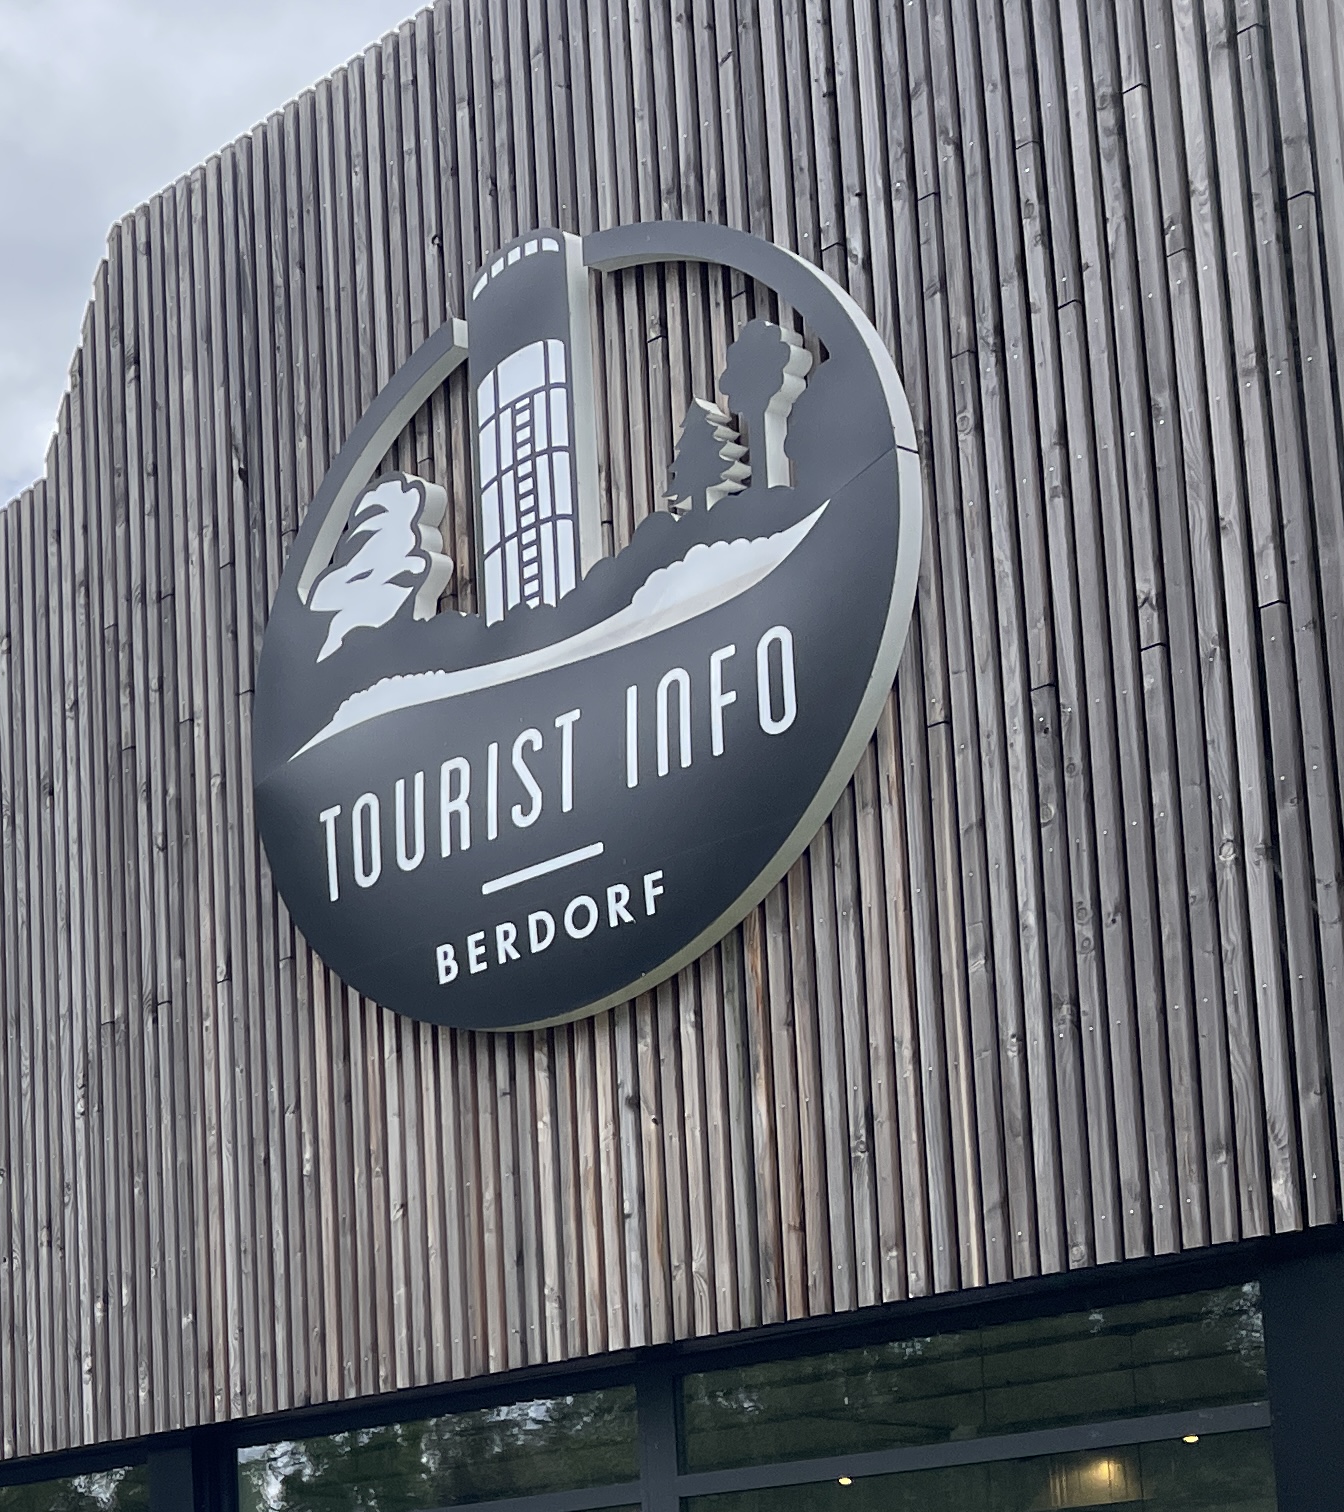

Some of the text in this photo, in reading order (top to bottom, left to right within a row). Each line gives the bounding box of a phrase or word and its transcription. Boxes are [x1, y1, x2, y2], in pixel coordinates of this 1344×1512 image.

[319, 625, 798, 902] TOURIST INFO
[435, 869, 666, 985] BERDORF
